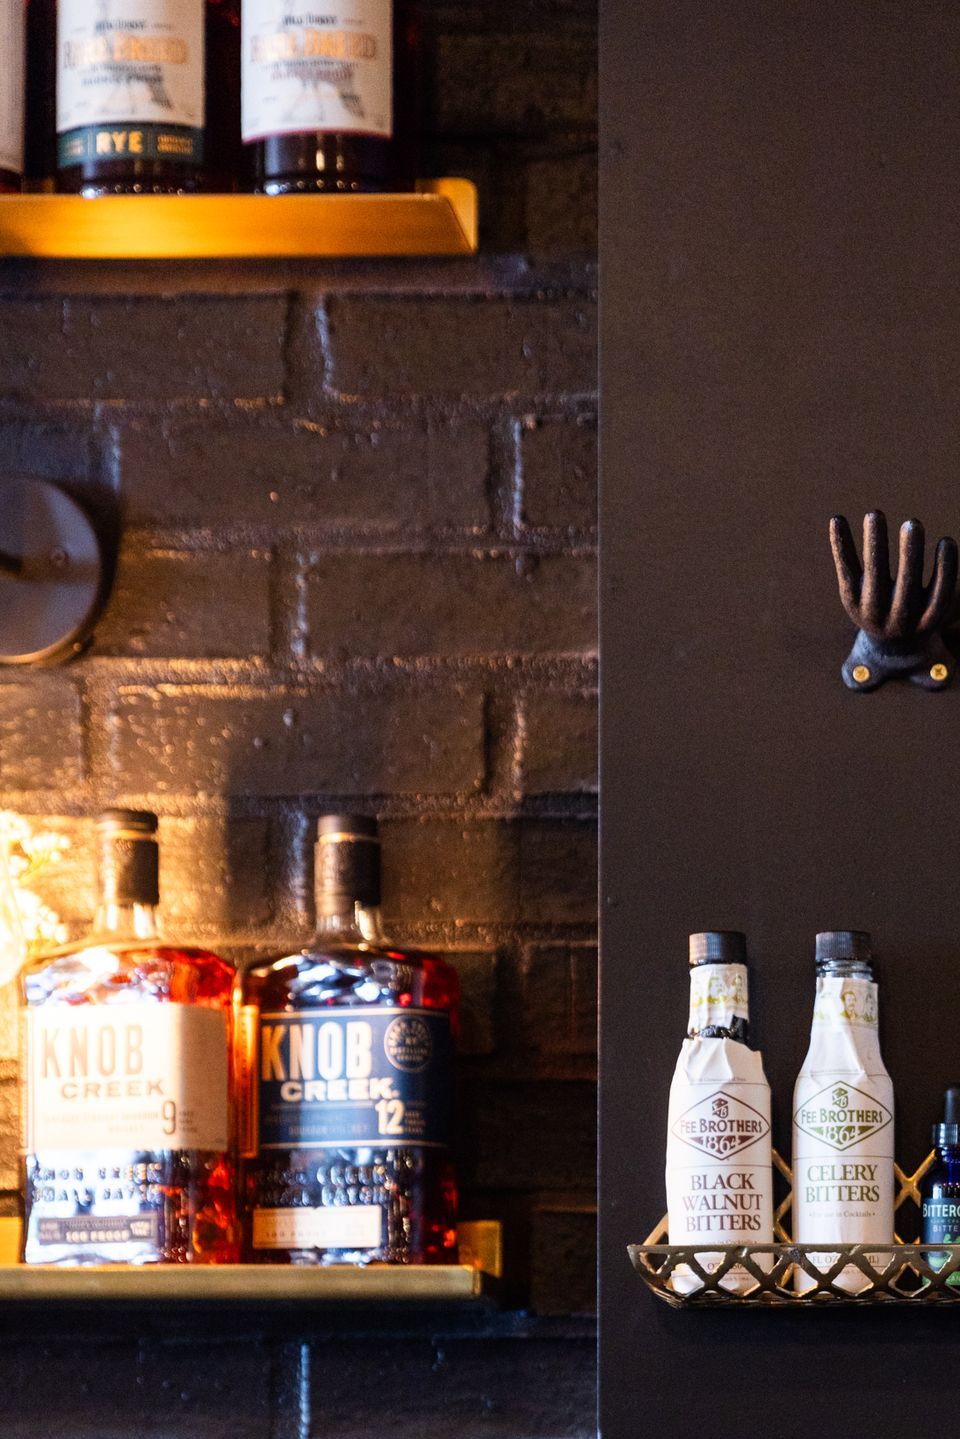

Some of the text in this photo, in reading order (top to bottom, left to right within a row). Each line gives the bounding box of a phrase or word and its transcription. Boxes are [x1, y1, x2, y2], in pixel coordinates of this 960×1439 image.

[96, 131, 143, 154] RYE
[43, 1023, 144, 1079] KNOB
[261, 1021, 373, 1082] KNOB
[61, 1078, 165, 1100] CREEK
[162, 1100, 177, 1136] 9
[375, 1099, 405, 1135] 12
[819, 1108, 883, 1123] BROTHERS
[699, 1118, 762, 1133] BROTHERS
[691, 1173, 755, 1191] BLACK
[807, 1164, 879, 1182] CELERY
[682, 1193, 763, 1212] WALNUT
[805, 1184, 880, 1203] BITTERS
[686, 1214, 761, 1232] BITTERS
